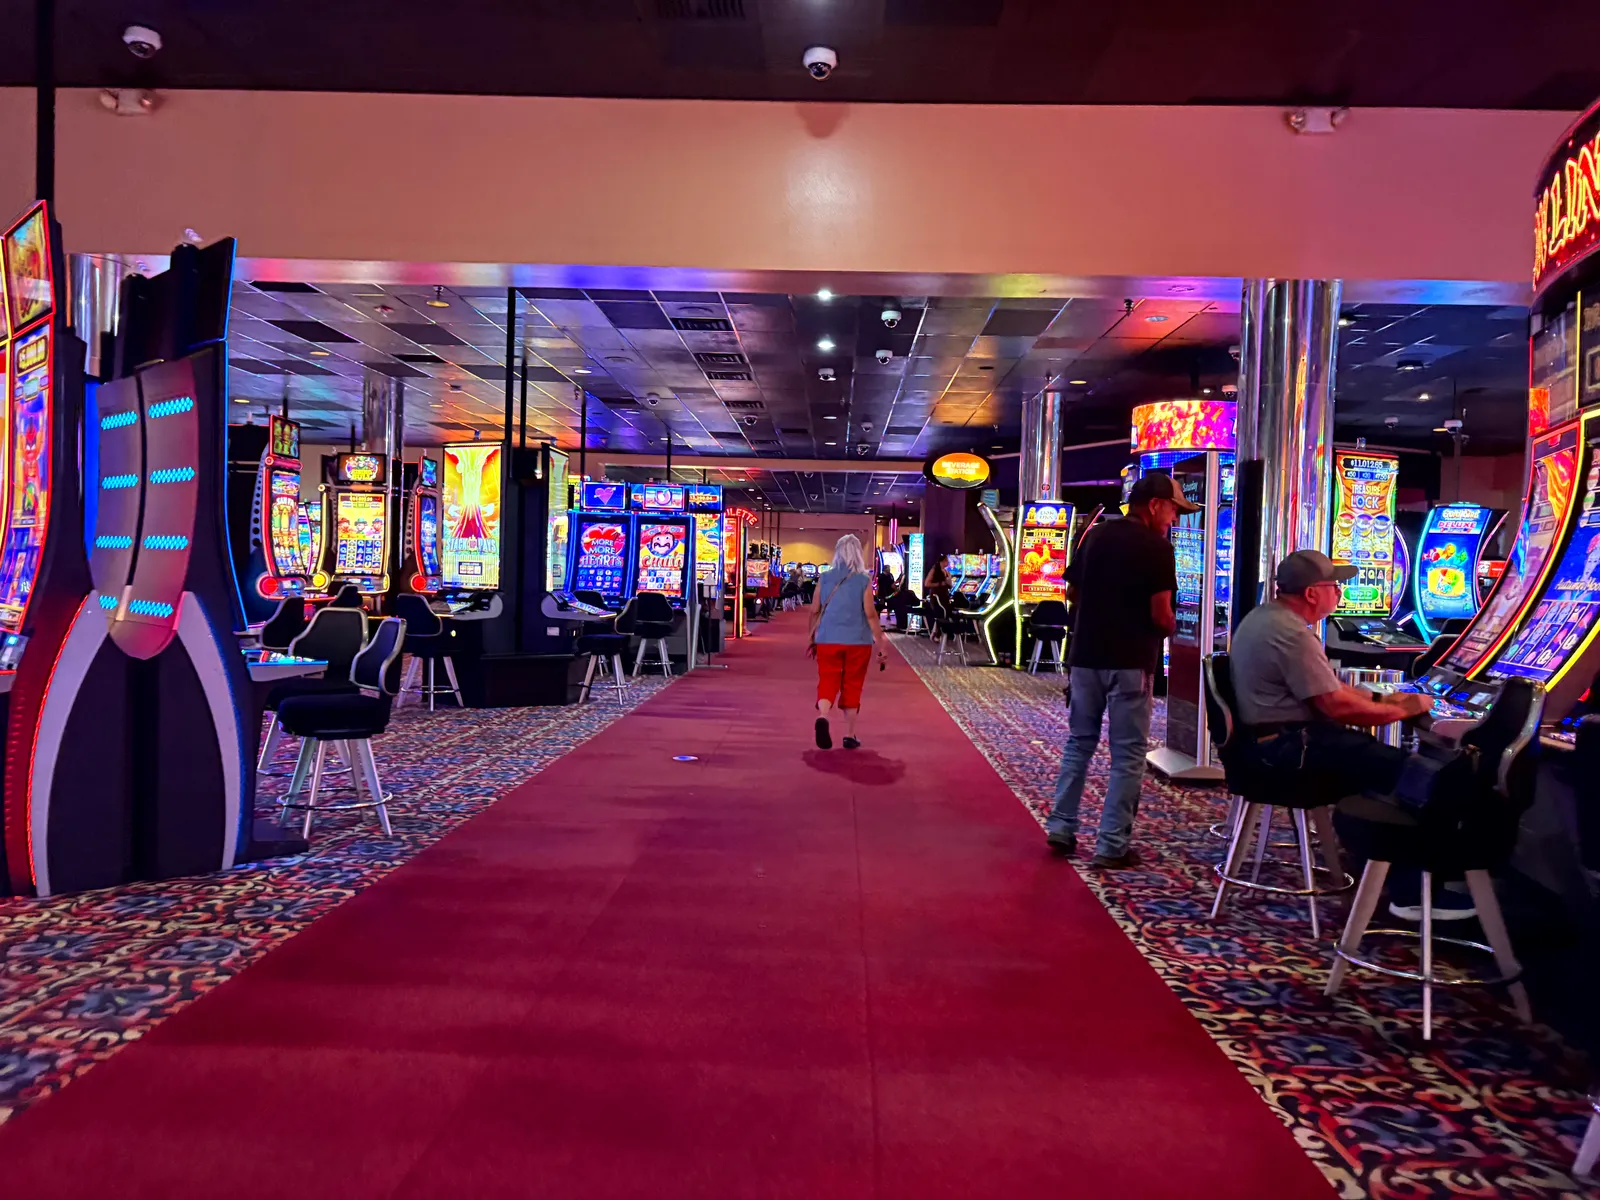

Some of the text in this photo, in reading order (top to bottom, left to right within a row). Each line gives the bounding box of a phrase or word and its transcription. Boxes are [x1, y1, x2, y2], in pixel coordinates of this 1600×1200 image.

[941, 461, 980, 469] BEVERAGE
[1351, 483, 1381, 495] TREASURE
[1350, 496, 1380, 509] LOCK
[477, 538, 496, 553] PAYS
[591, 539, 614, 547] MORE
[589, 546, 616, 555] MORE
